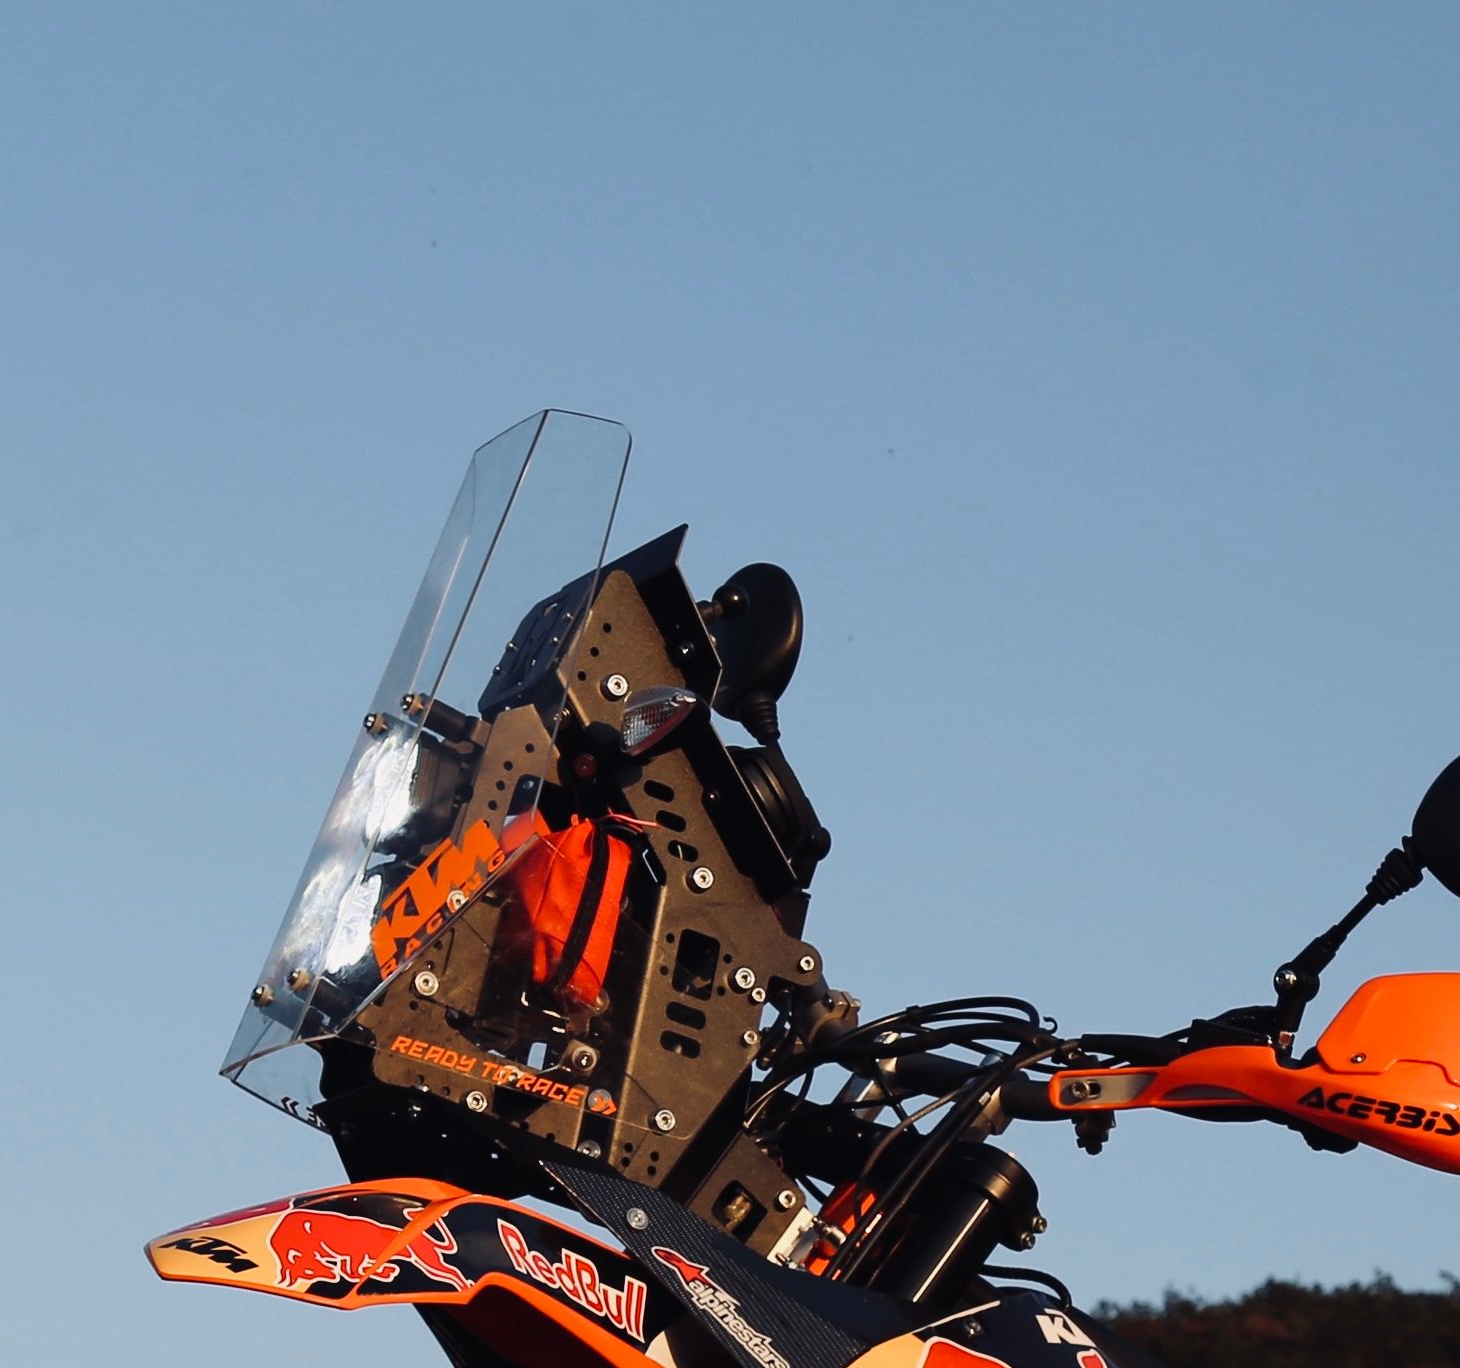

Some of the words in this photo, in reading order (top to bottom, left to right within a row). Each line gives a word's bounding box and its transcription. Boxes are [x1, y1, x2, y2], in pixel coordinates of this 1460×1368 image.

[371, 819, 500, 969] KTM
[391, 1035, 477, 1073] READY
[482, 1061, 512, 1085] TO
[516, 1073, 585, 1106] RACE
[157, 1236, 259, 1273] KTM
[1035, 1308, 1097, 1348] KT
